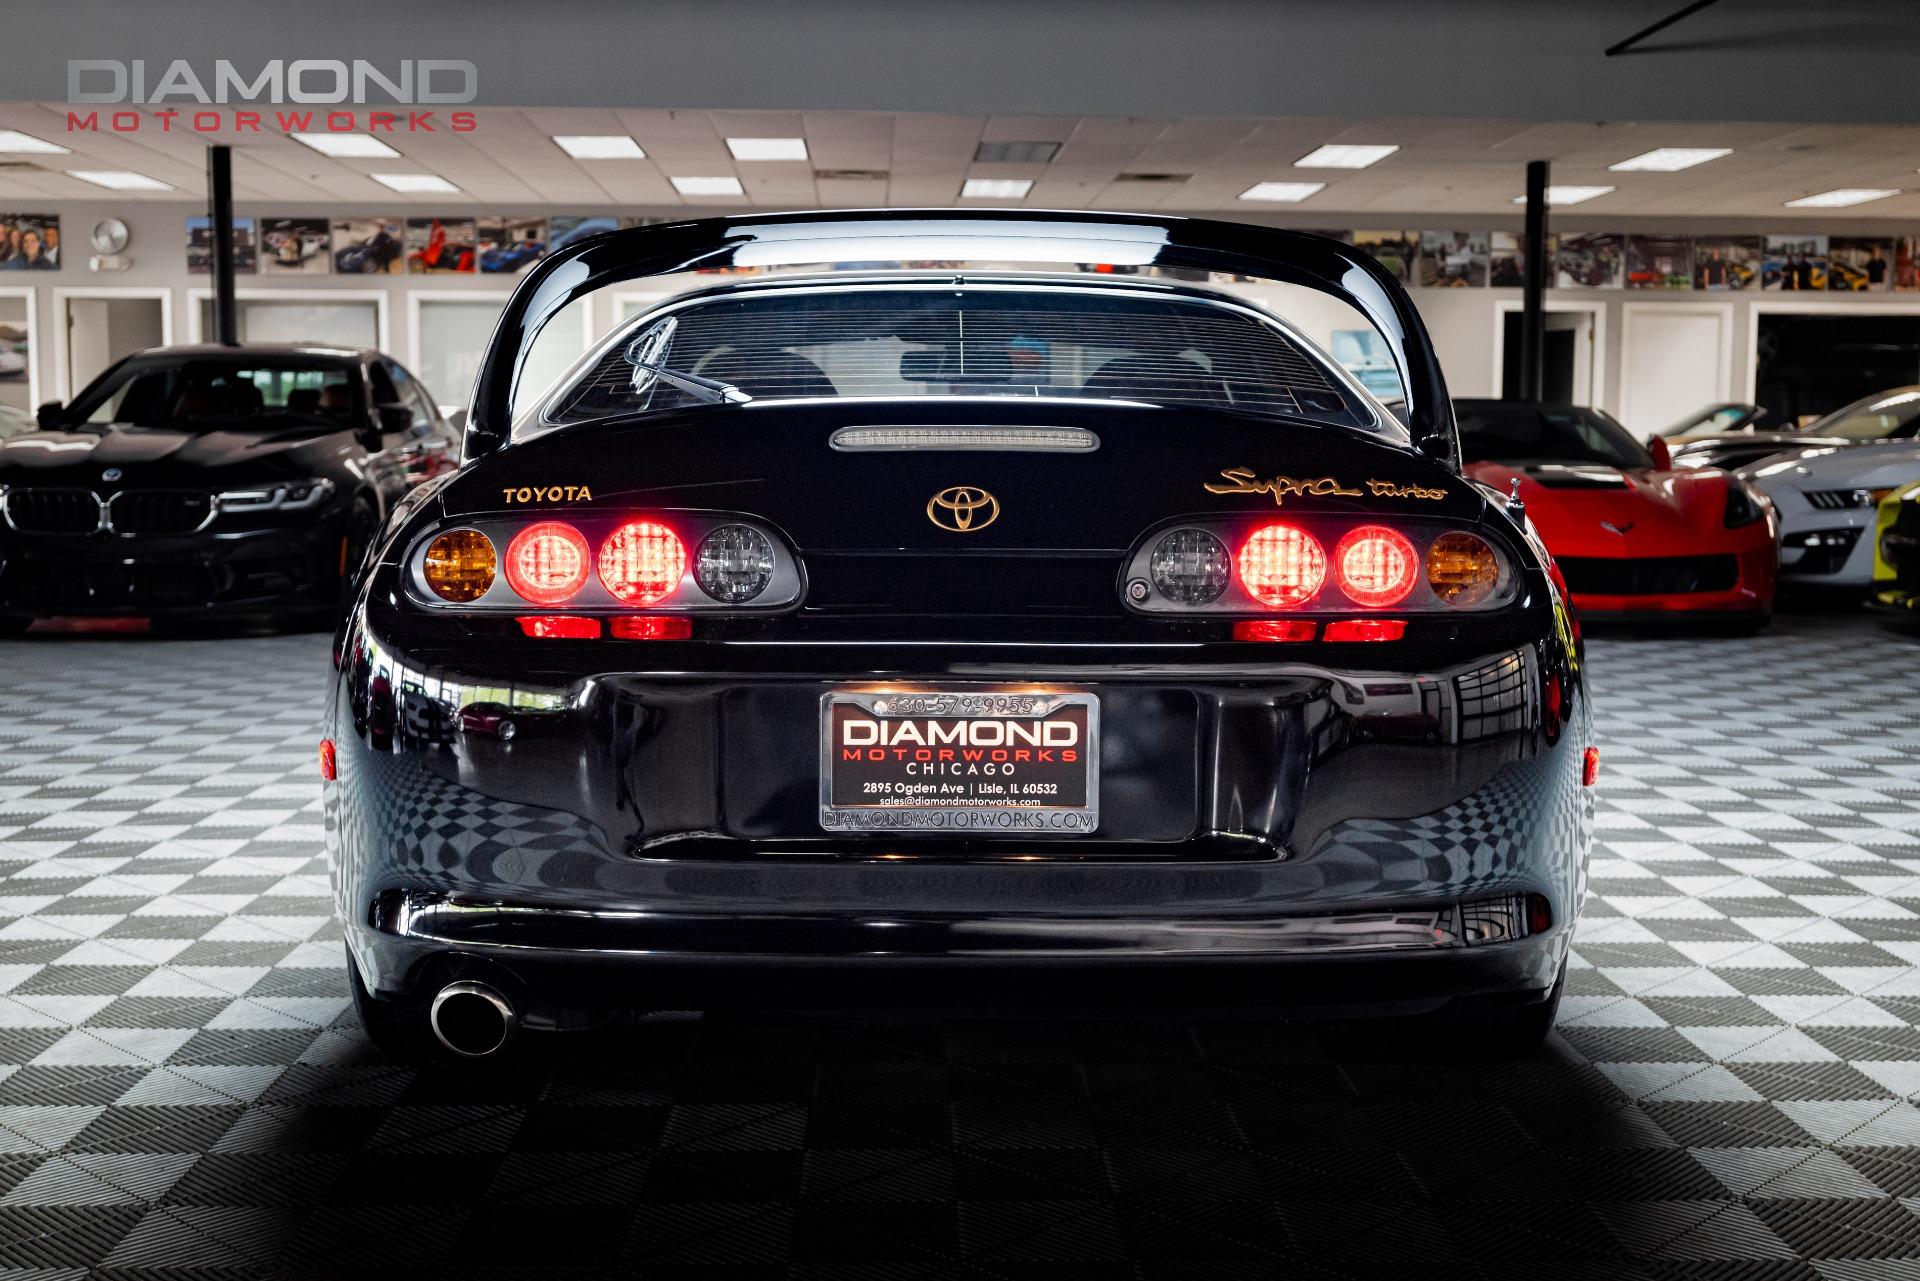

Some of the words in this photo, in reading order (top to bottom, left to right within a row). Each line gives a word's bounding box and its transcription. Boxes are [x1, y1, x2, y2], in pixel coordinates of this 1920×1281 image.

[502, 485, 593, 504] TOYOTA
[1203, 466, 1363, 506] Supra
[887, 696, 1034, 713] 630-579-9955
[843, 720, 1078, 747] DIAMOND
[843, 749, 1078, 762] MOTORWORKS
[906, 762, 1015, 776] CHICAGO
[863, 783, 892, 793] 2895
[894, 782, 937, 795] Ogden
[940, 783, 965, 793] Ave
[978, 783, 1006, 795] Lisle,
[1010, 784, 1019, 794] IL
[1022, 784, 1058, 795] 60532
[879, 795, 1041, 807] sales@diamondmotorworks.com
[824, 811, 1095, 828] DIAMONDMOTORWORKS.COM
